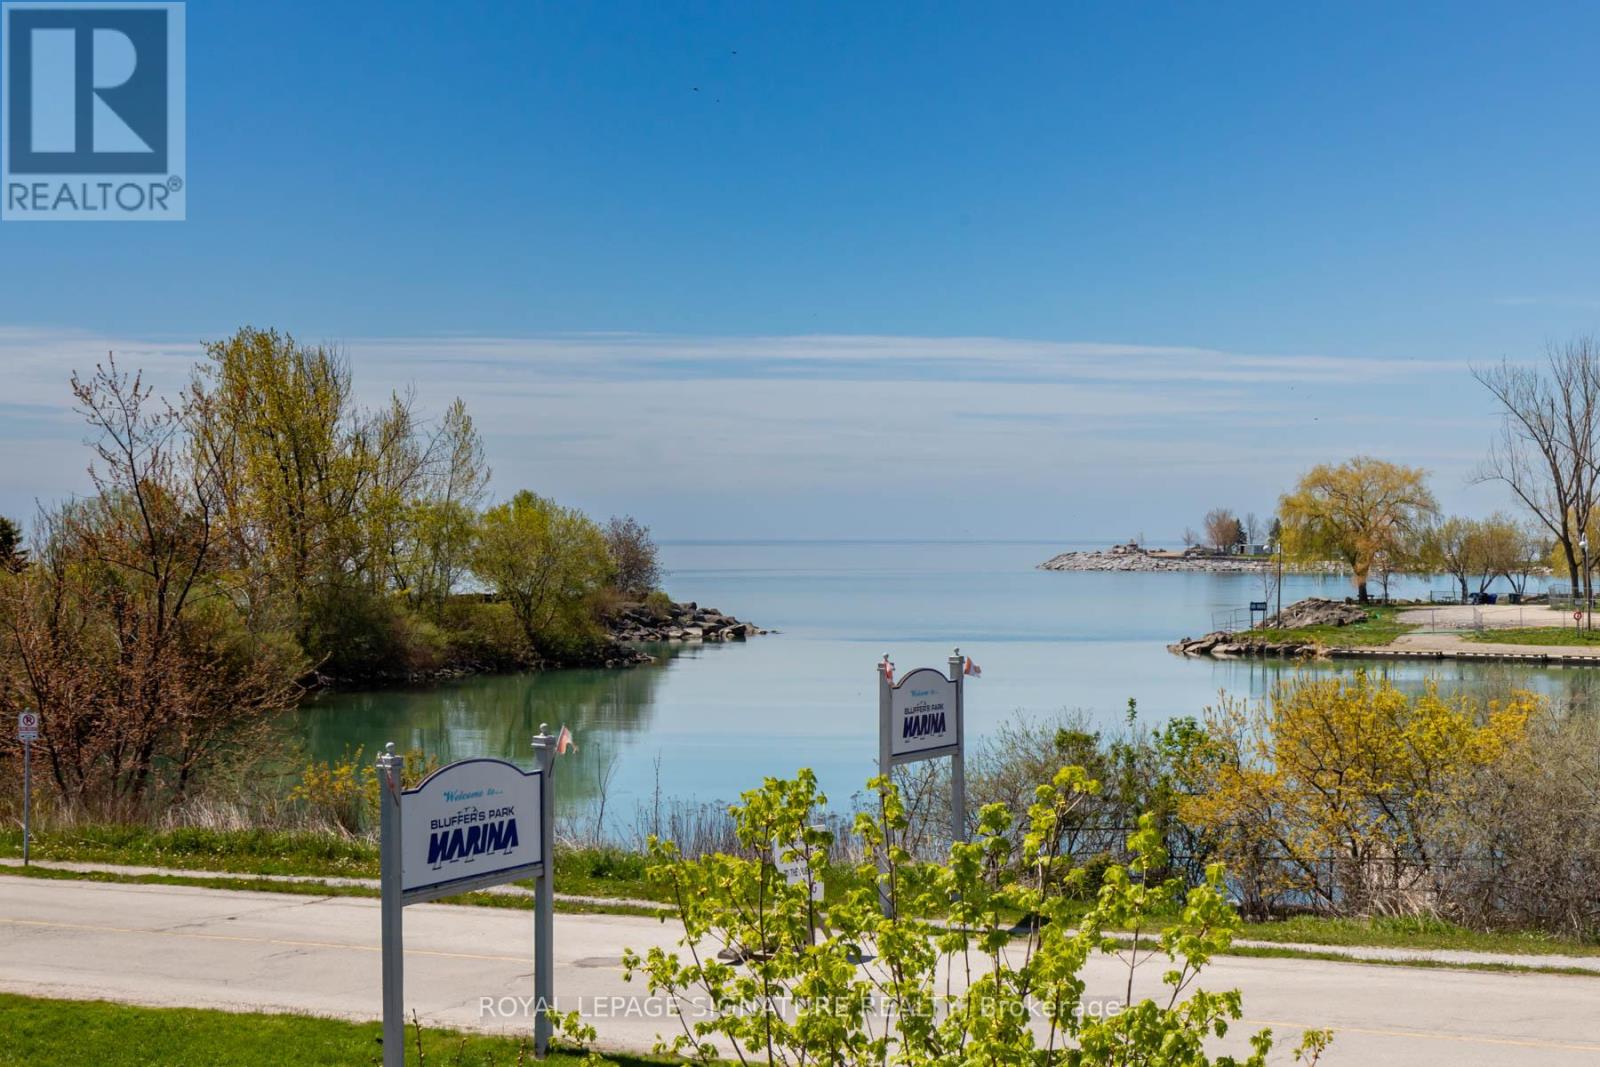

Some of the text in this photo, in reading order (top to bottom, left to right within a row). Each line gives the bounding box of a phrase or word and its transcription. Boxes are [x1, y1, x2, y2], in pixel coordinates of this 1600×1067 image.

[903, 711, 946, 739] MARINA
[443, 788, 484, 803] Welcome
[488, 805, 515, 819] PARK
[427, 818, 519, 865] MARINA
